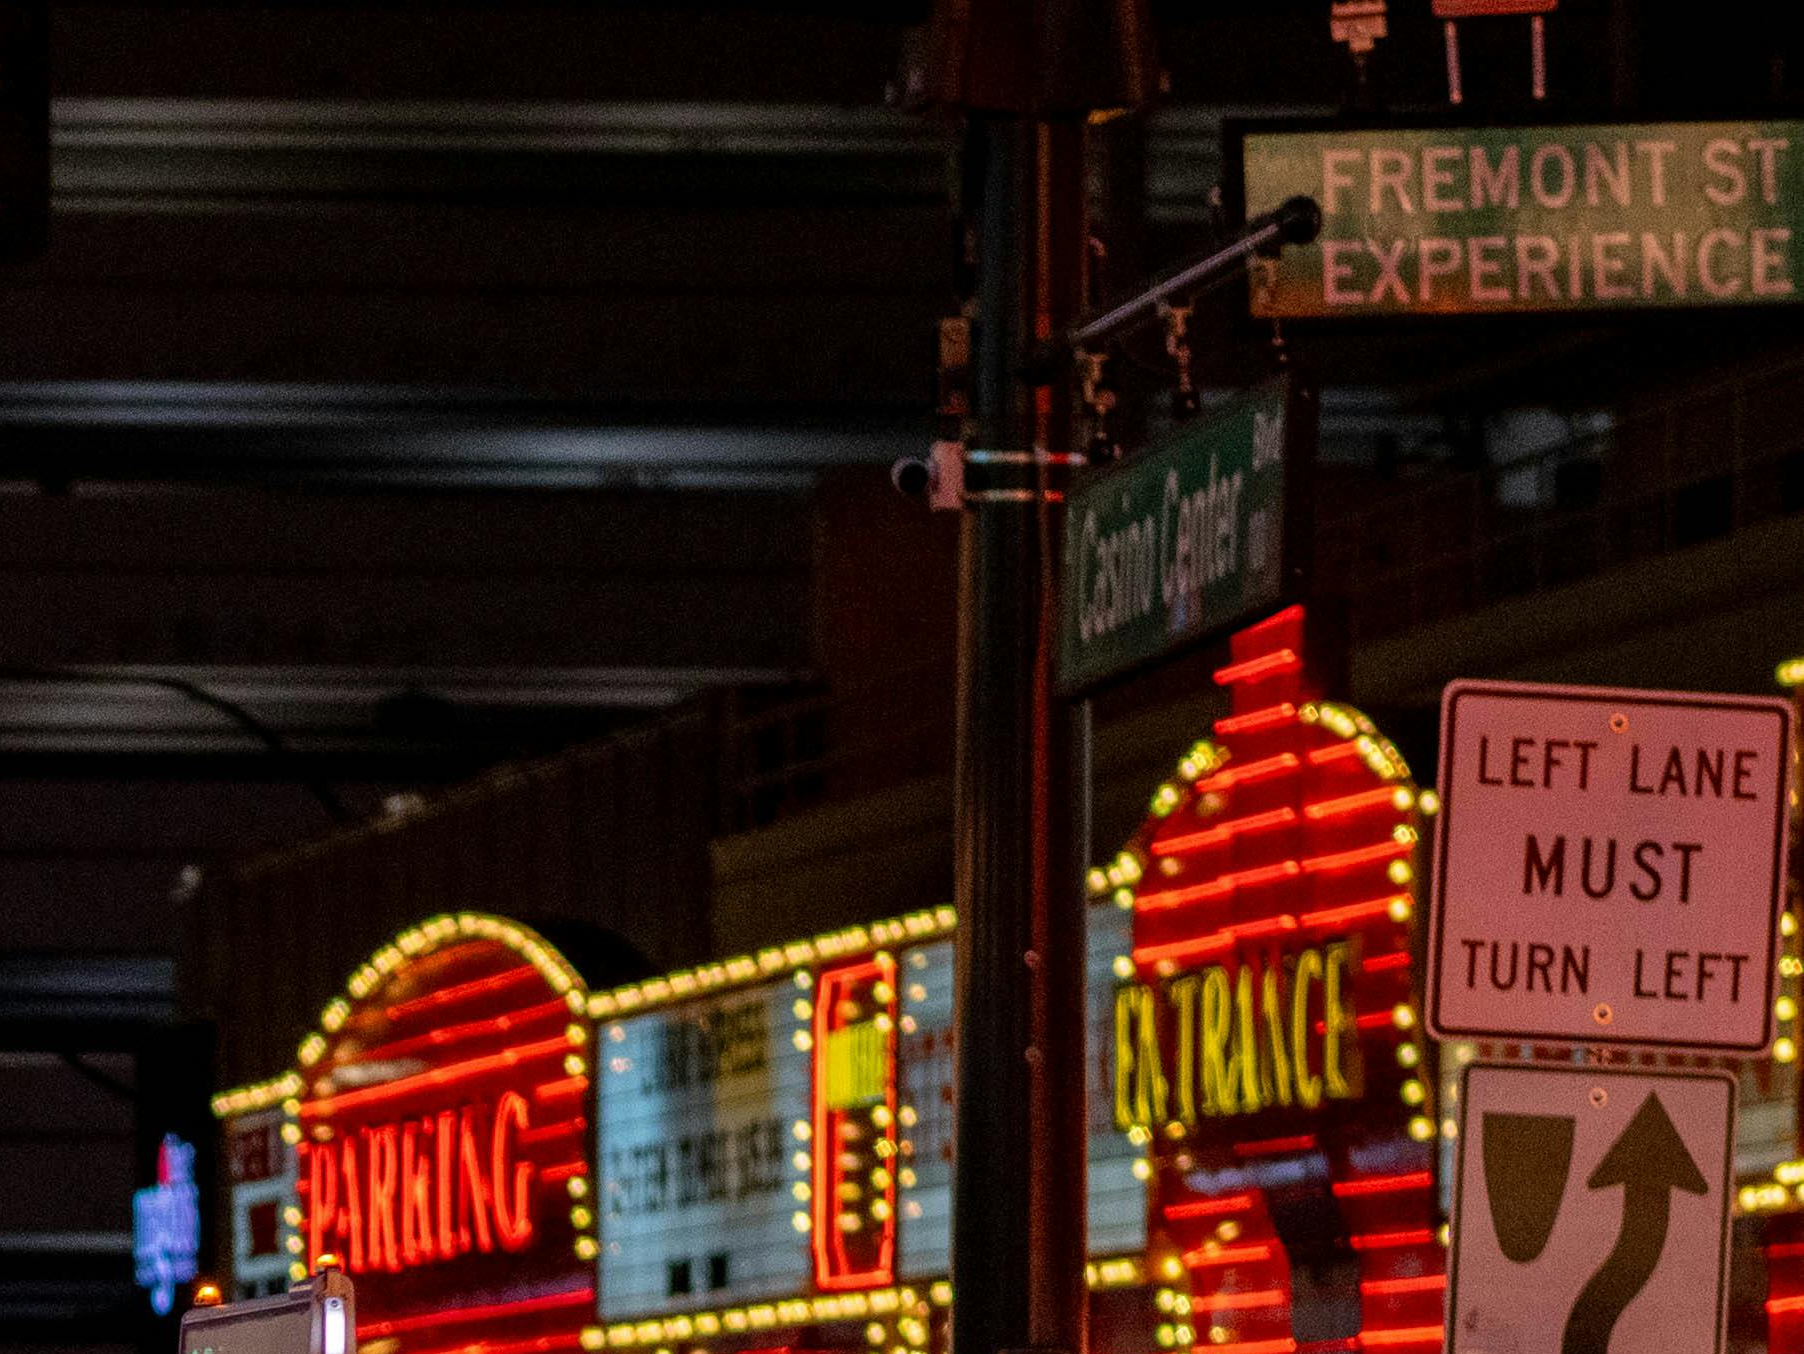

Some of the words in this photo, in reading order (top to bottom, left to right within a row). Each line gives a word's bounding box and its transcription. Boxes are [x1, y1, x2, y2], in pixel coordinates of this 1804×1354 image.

[1322, 140, 1676, 215] FREMONT
[1702, 137, 1790, 207] ST
[1322, 228, 1793, 305] EXPERIENCE
[1080, 492, 1155, 641] Casino
[1478, 736, 1598, 790] LEFT
[1629, 744, 1758, 800] LANE
[1522, 834, 1703, 904] MUST
[1461, 939, 1591, 994] TURN
[1634, 949, 1750, 1002] LEFT
[1114, 944, 1354, 1129] ENTRANCE
[308, 1091, 535, 1274] PARKING
